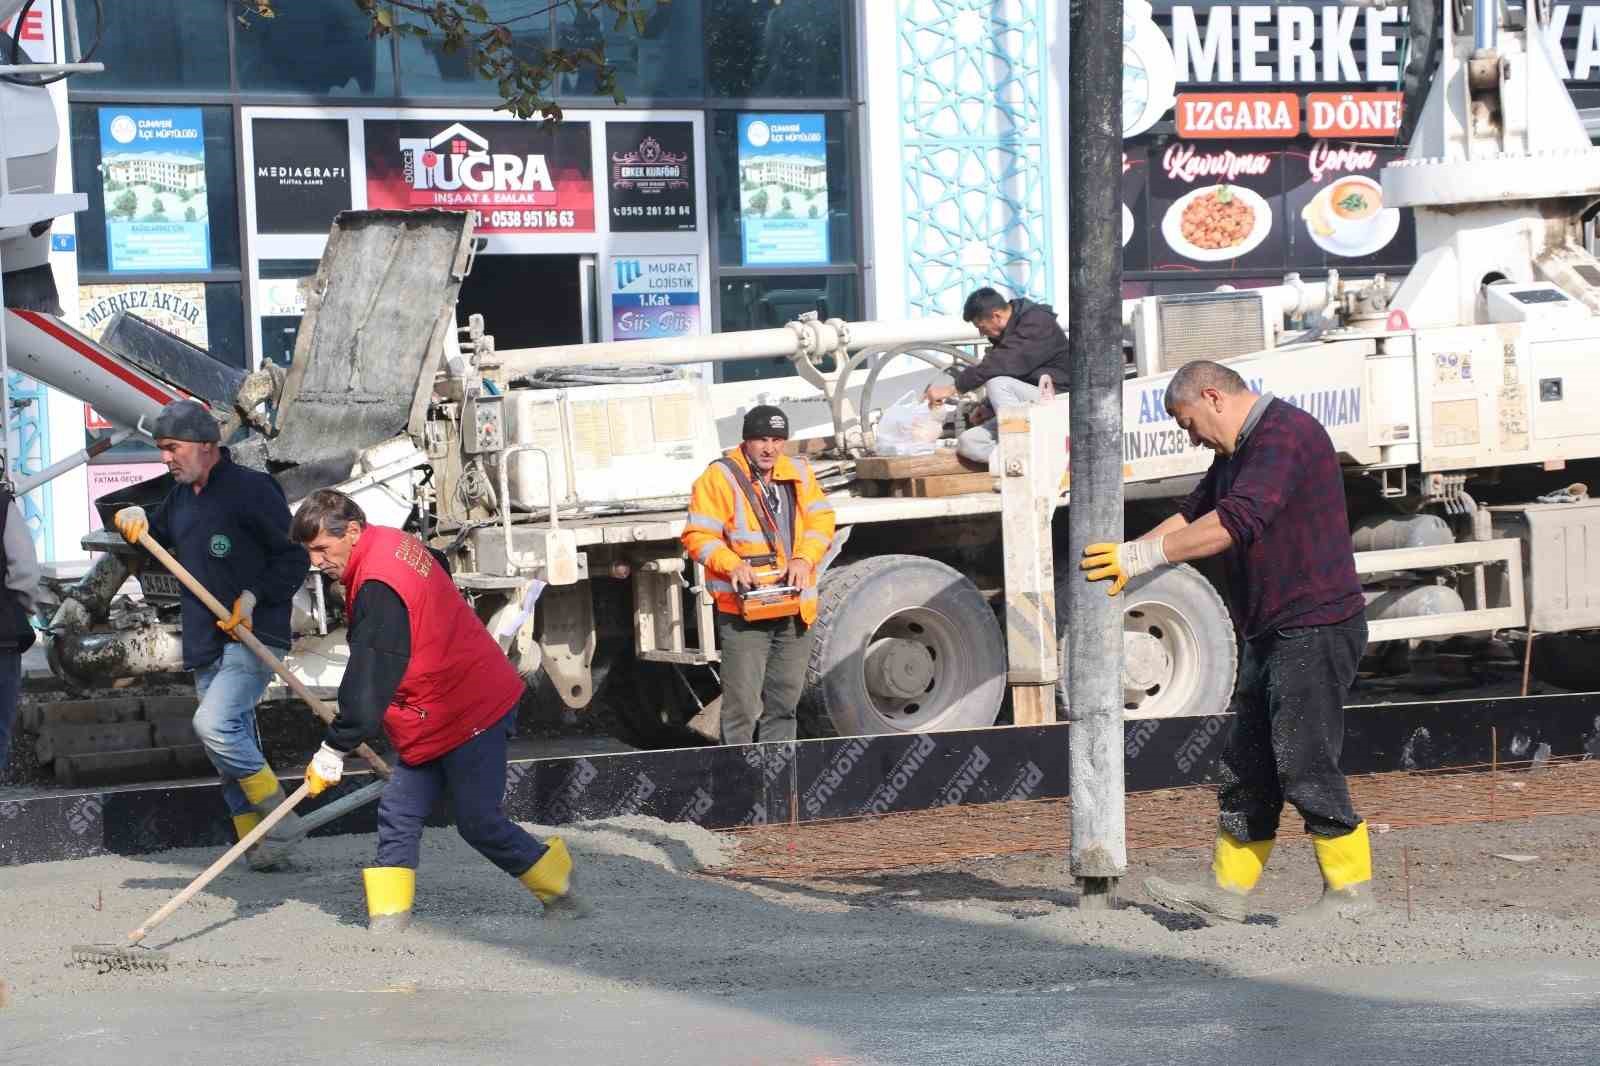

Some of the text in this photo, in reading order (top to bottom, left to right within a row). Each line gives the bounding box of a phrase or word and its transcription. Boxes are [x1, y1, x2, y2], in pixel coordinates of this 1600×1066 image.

[1172, 5, 1412, 82] MERKE
[1183, 101, 1293, 131] IZGARA
[1312, 94, 1402, 131] DÖNE
[399, 138, 554, 191] TUĞRA
[404, 150, 414, 184] DÜZCE
[1163, 143, 1271, 182] Kavurma
[1309, 141, 1376, 182] Çorba
[494, 193, 536, 204] EMLAK
[491, 211, 522, 227] 0538
[523, 210, 543, 227] 951
[544, 210, 558, 227] 16
[559, 210, 576, 227] 63
[648, 263, 695, 274] MURAT
[86, 290, 199, 327] MERKEZ AKTAR
[639, 294, 671, 307] 1.Kat
